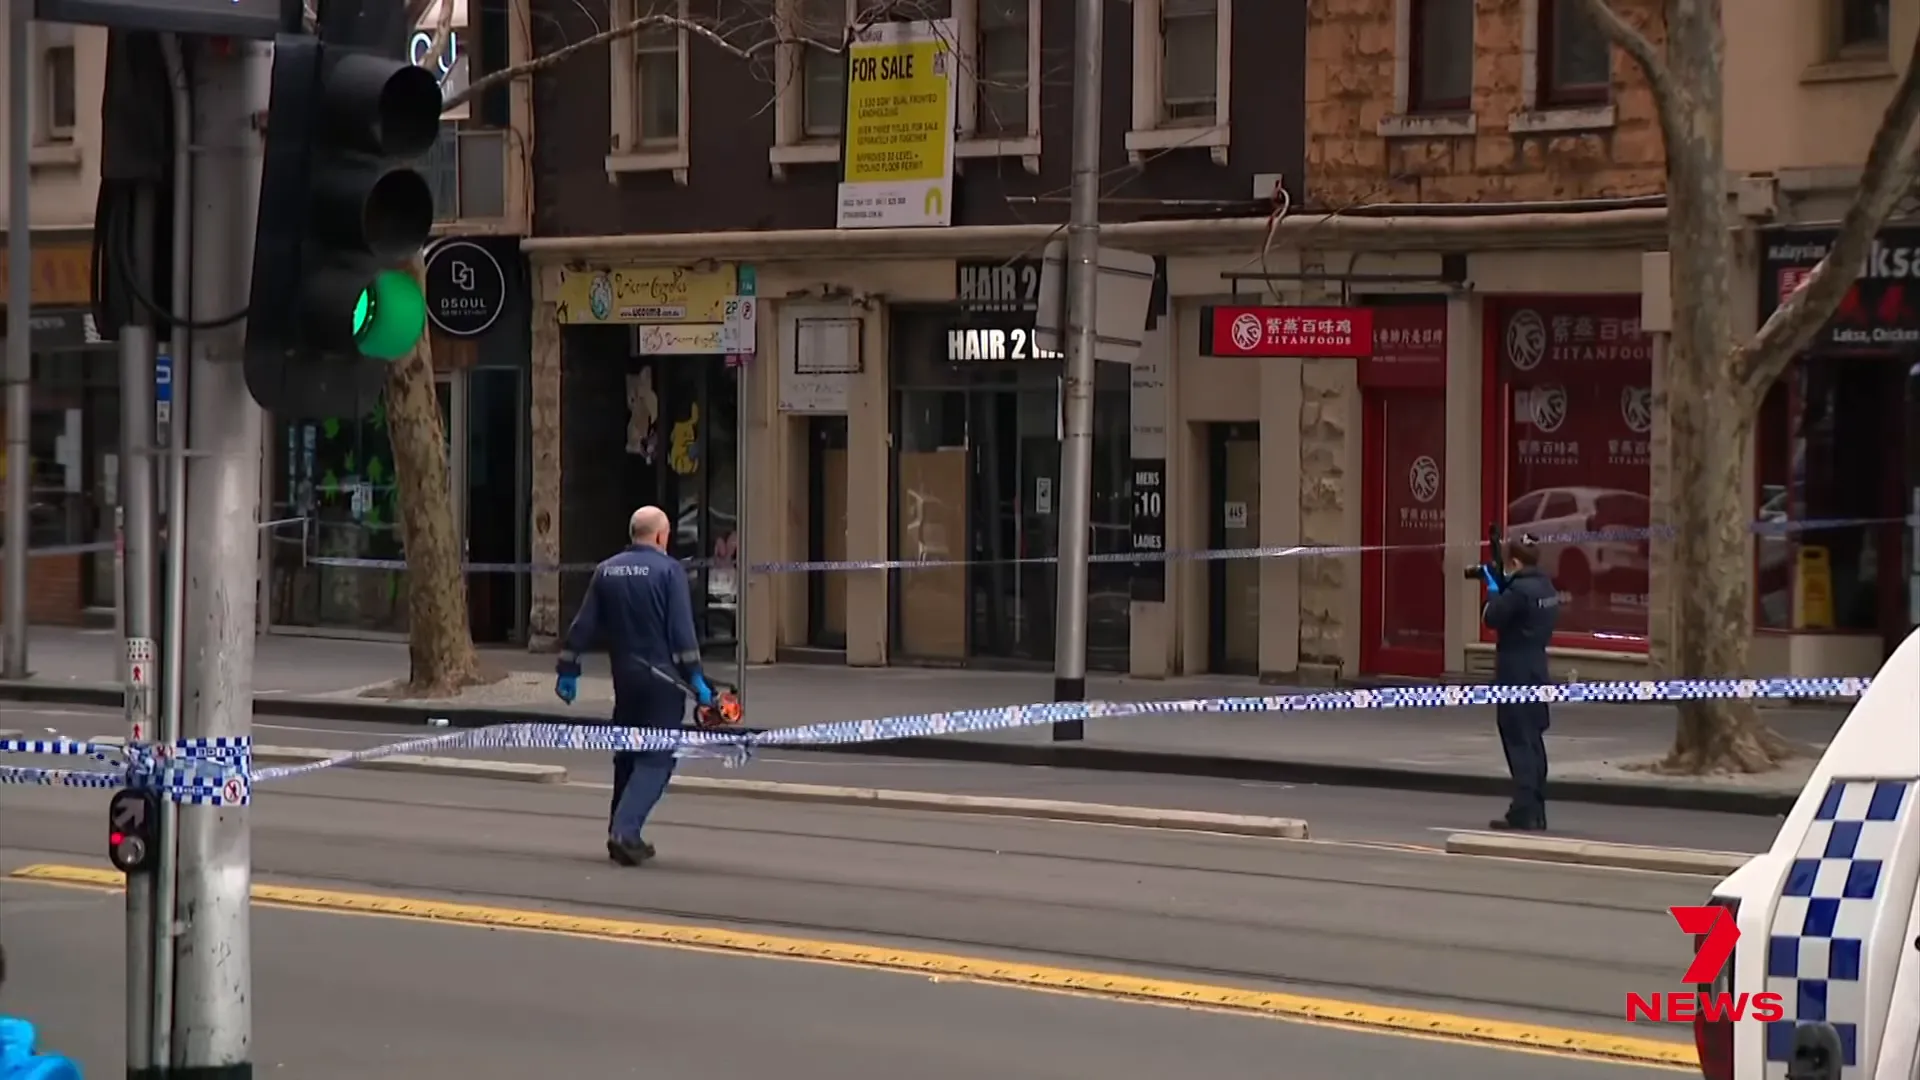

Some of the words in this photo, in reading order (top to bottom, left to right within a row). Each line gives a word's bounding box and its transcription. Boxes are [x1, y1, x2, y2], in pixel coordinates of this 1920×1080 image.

[851, 57, 877, 82] FOR
[881, 54, 914, 80] SALE
[960, 266, 1017, 300] HAIR
[1022, 266, 1037, 300] 2
[441, 297, 487, 309] DSOUL
[725, 301, 738, 315] 2P
[1266, 317, 1352, 334] 紫燕百味鸡
[948, 329, 1005, 360] HAIR
[1010, 328, 1026, 360] 2
[1267, 336, 1352, 345] ZIYANFOODS
[1136, 472, 1160, 485] MENS
[1229, 506, 1243, 518] 445
[1133, 534, 1162, 548] LADIES
[603, 566, 649, 576] FORENSIC
